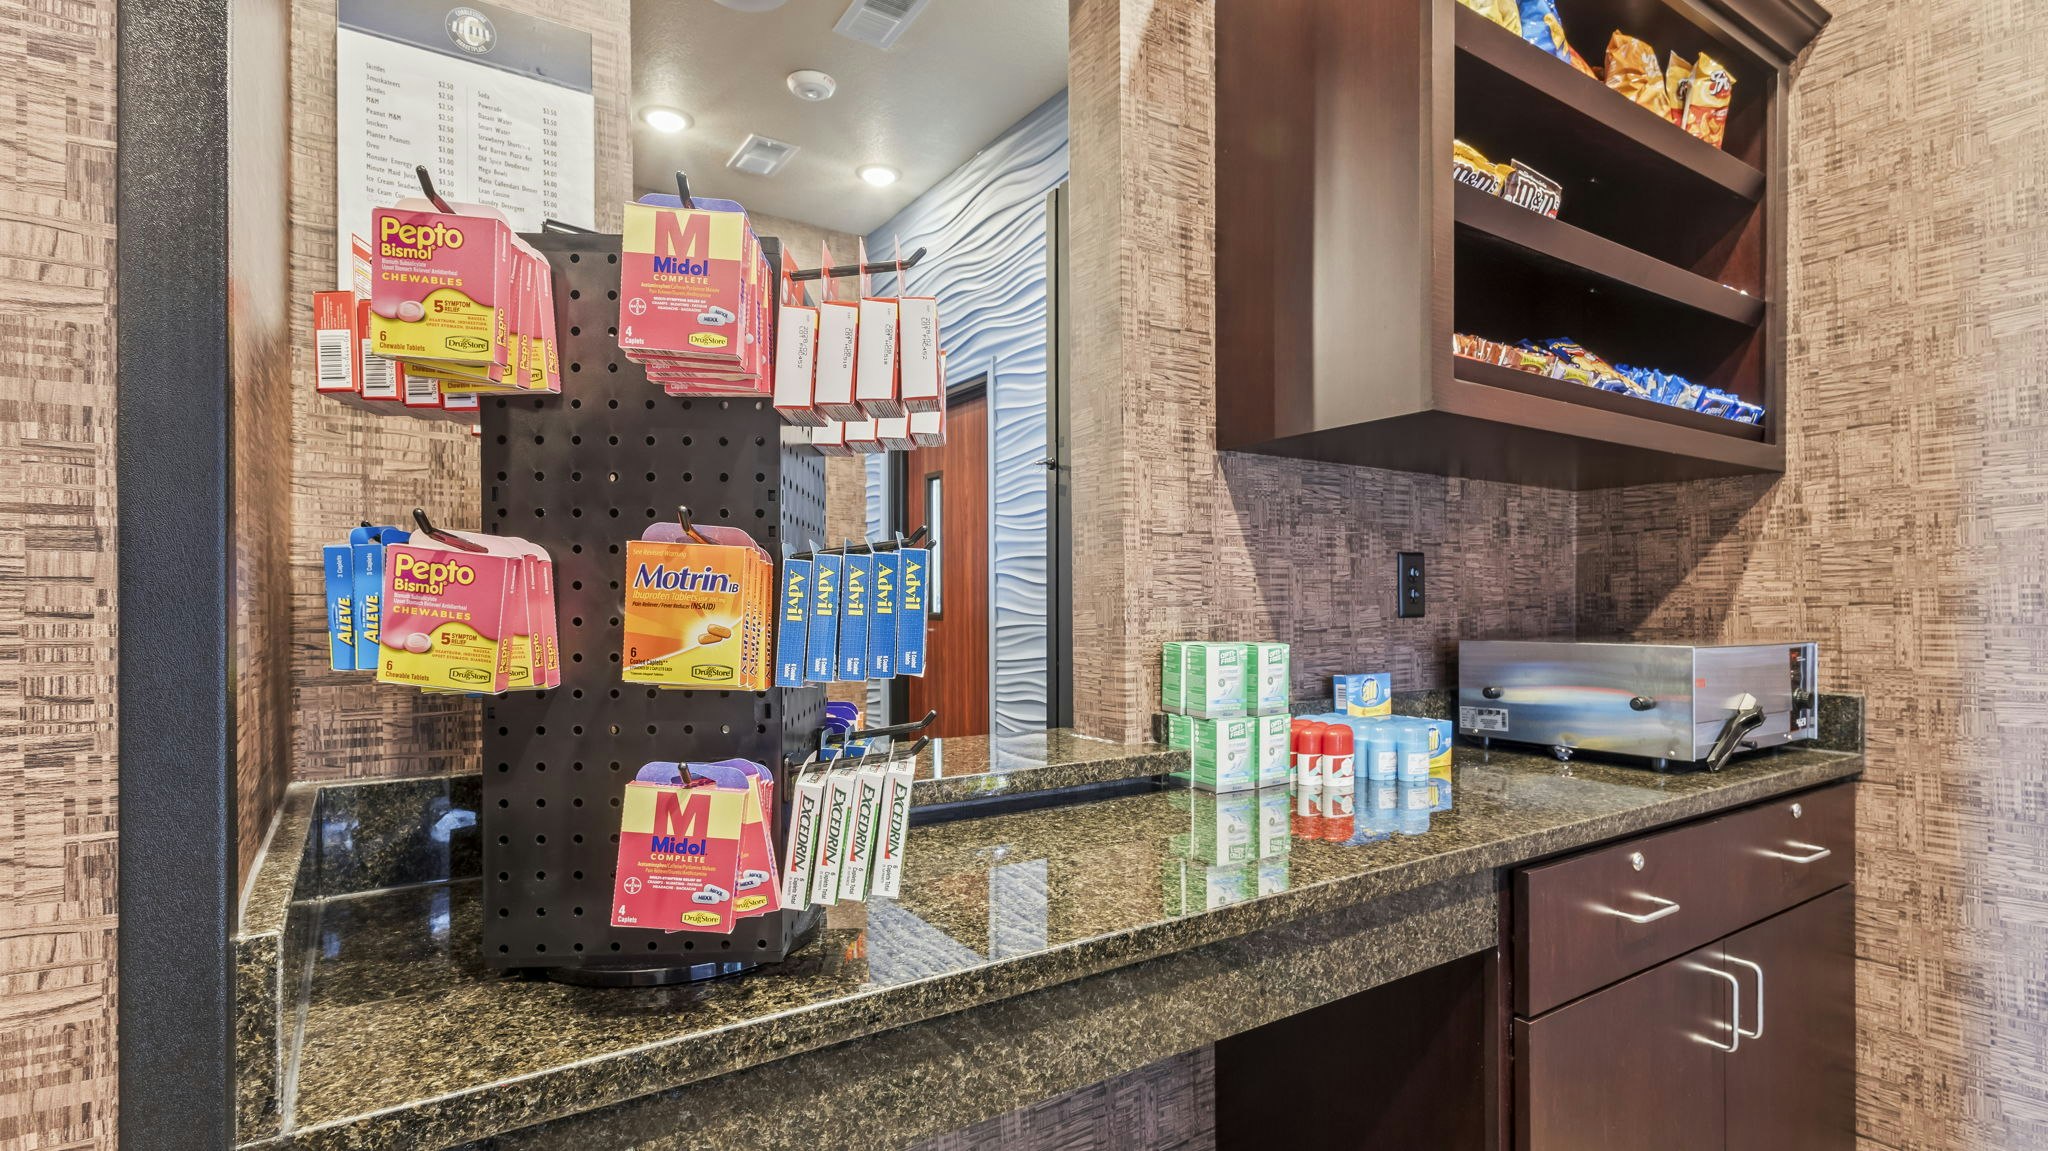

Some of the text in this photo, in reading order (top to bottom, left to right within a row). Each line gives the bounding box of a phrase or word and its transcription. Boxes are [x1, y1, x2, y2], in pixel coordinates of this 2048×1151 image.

[366, 107, 386, 118] Peanut
[388, 112, 402, 120] M&M
[498, 118, 512, 126] Water
[366, 152, 388, 162] Monster
[366, 164, 384, 173] Minute
[388, 168, 400, 176] Maid
[378, 177, 394, 186] Cream
[380, 216, 464, 250] Pepto
[654, 211, 710, 258] M
[380, 242, 432, 260] Bismol
[653, 256, 709, 276] Midol
[382, 272, 463, 286] CHEWABLES
[654, 274, 709, 285] COMPLETE
[434, 300, 470, 312] 5 SYMPTOM
[380, 330, 386, 342] 6
[496, 308, 505, 346] Pepto
[626, 326, 632, 337] 4
[380, 342, 426, 352] Chewable Tablets
[624, 337, 644, 345] Caplets
[520, 334, 528, 370] Pepto
[548, 338, 556, 374] Pepto
[336, 554, 344, 574] Caplets
[395, 553, 474, 584] Pepto
[394, 578, 444, 594] Bismol
[634, 563, 740, 593] Motrin IB
[905, 559, 922, 610] Advil
[632, 590, 670, 600] Ibuprofen
[672, 592, 698, 601] Tablets
[786, 569, 806, 622] Advil
[816, 563, 834, 616] Advil
[848, 564, 865, 616] Advil
[877, 562, 894, 614] Advil
[393, 606, 471, 620] CHEWABLES
[690, 602, 716, 611] (NSAID)
[441, 632, 478, 645] 5 SYMPTOM
[499, 638, 508, 674] Pepto
[534, 632, 542, 668] Pepto
[546, 636, 554, 670] Pepto
[630, 647, 637, 658] 6
[386, 660, 393, 671] 6
[385, 671, 430, 682] Chewable Tablets
[654, 792, 712, 836] M
[854, 783, 876, 860] EXCEDRIN
[888, 782, 908, 858] EXCEDRIN
[796, 794, 815, 871] EXCEDRIN
[827, 788, 847, 864] EXCEDRIN
[652, 836, 707, 856] Midol
[650, 853, 706, 864] COMPLETE
[618, 904, 626, 916] 4
[618, 916, 637, 924] Caplets
